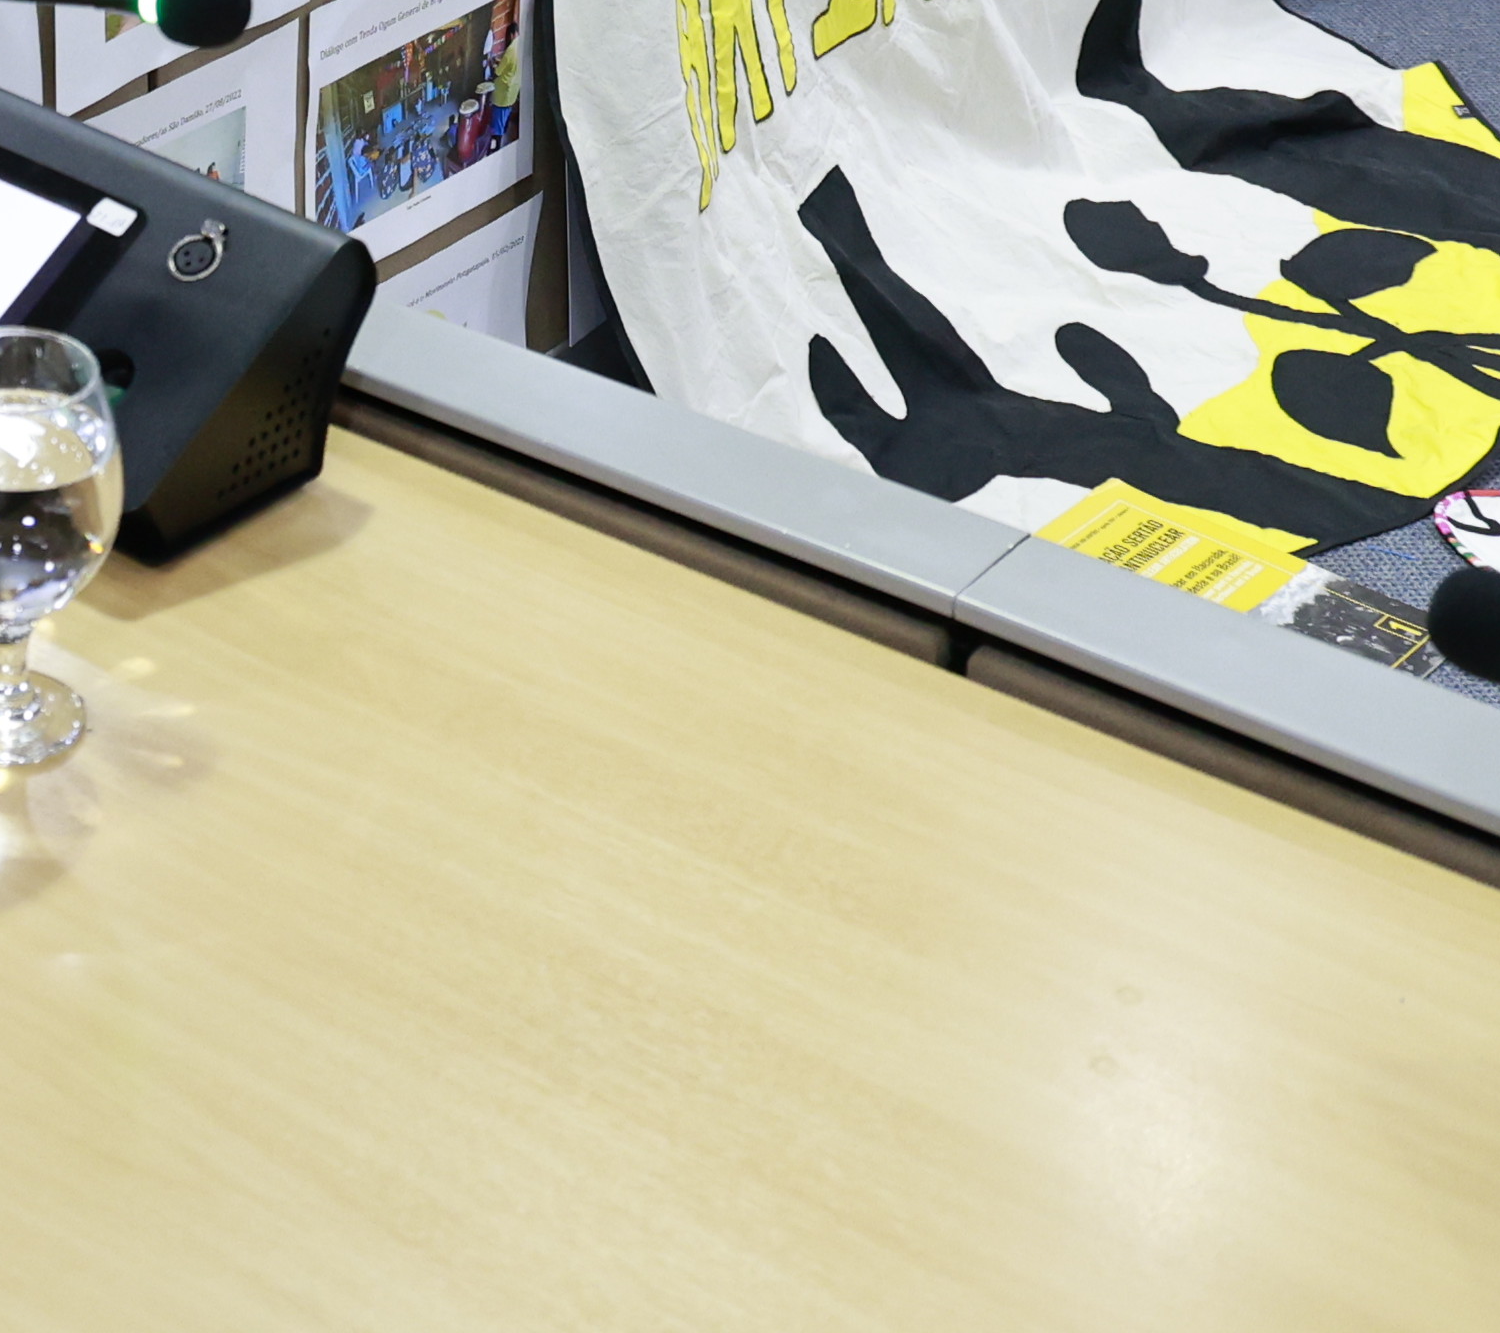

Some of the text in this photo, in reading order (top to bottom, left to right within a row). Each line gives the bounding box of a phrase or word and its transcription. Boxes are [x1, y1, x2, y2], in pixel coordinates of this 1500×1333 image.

[320, 44, 344, 61] Diálogo
[345, 36, 358, 49] com
[1099, 541, 1130, 564] AÇÃO
[1124, 518, 1164, 547] SERTÃO
